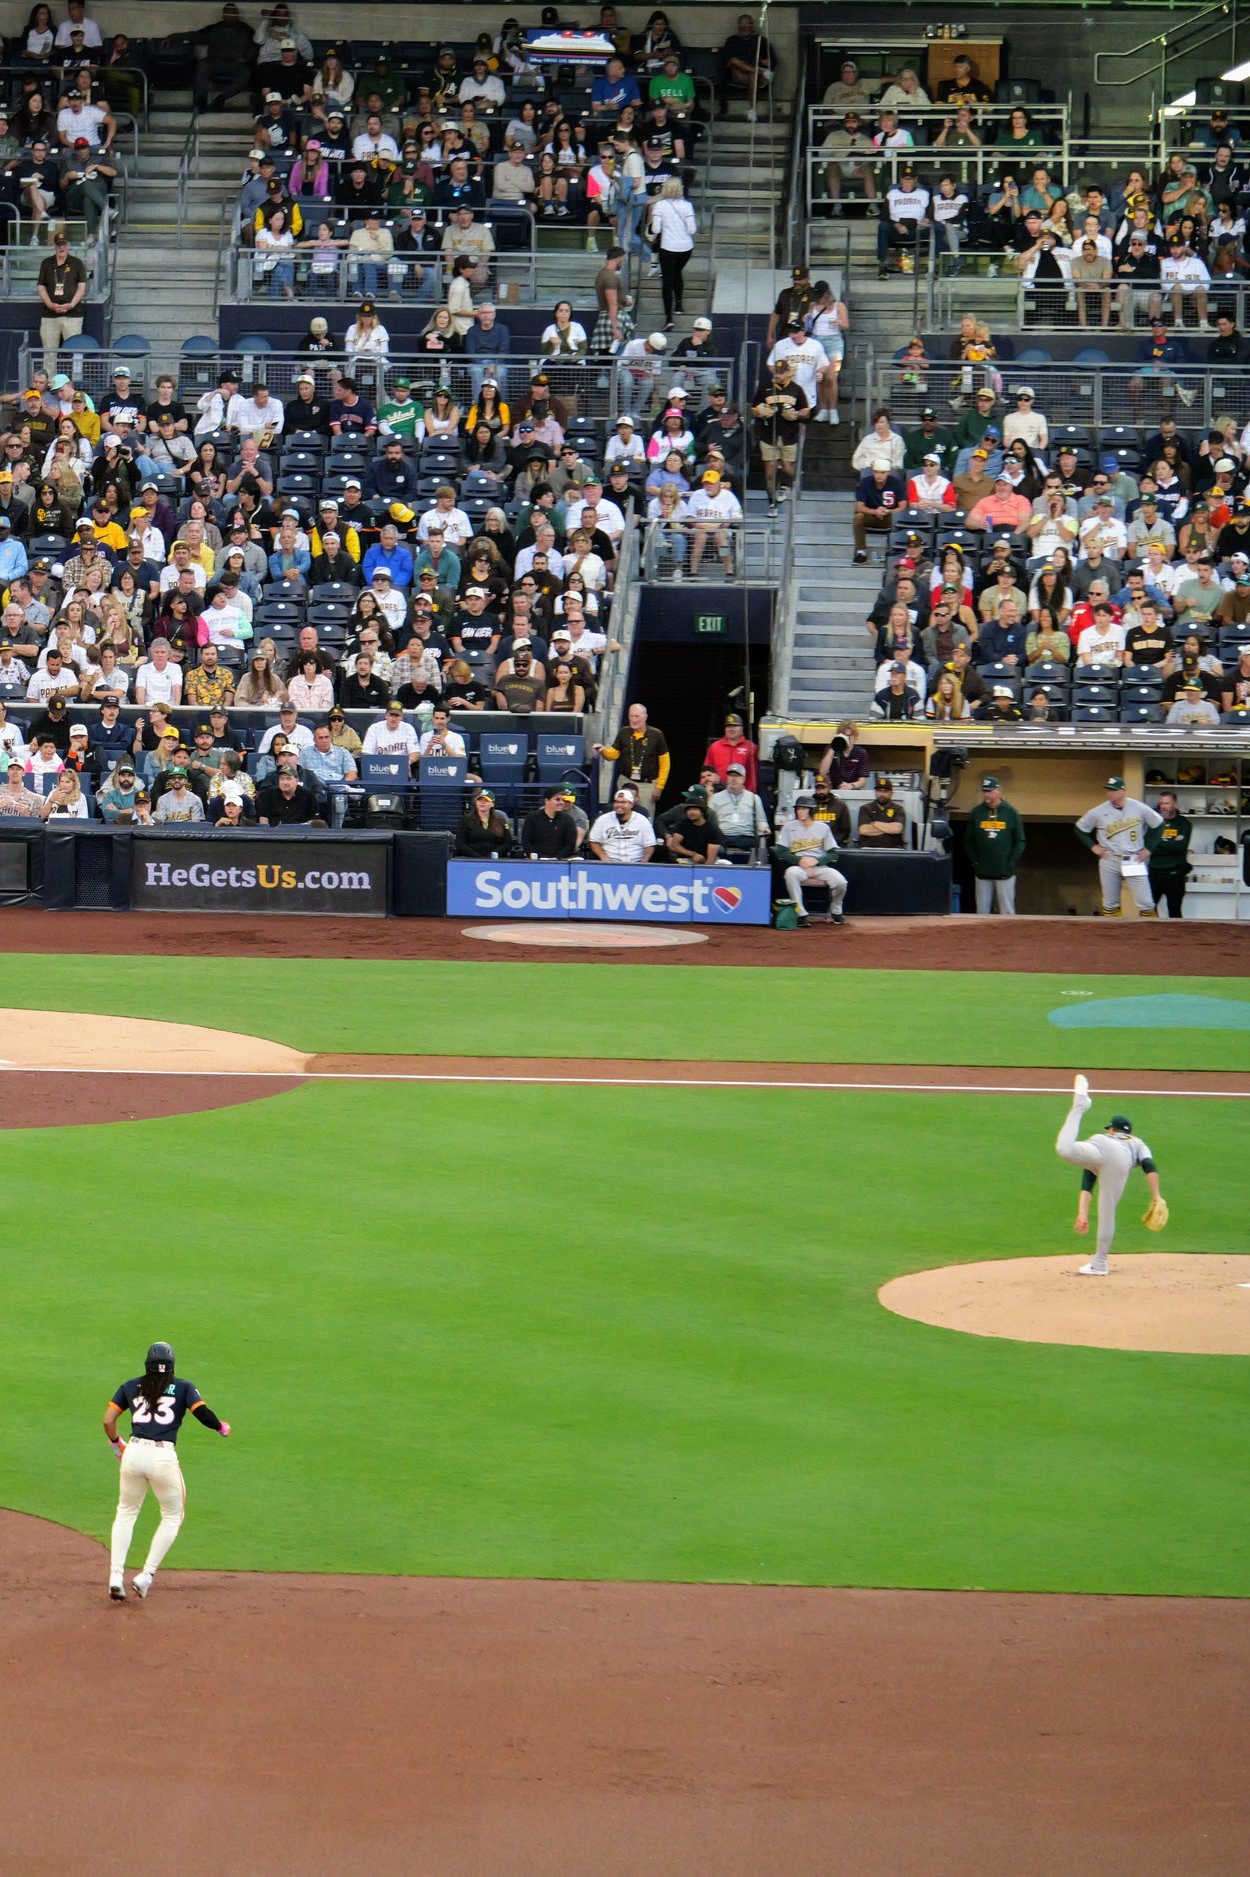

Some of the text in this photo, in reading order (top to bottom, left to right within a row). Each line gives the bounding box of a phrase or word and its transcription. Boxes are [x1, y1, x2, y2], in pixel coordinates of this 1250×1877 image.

[661, 88, 684, 98] SELL
[699, 616, 723, 632] EXIT
[488, 743, 508, 754] blue
[546, 744, 566, 755] blue
[369, 763, 390, 774] blue
[428, 765, 448, 776] blue
[145, 861, 372, 890] HeGetsUs.com
[474, 870, 710, 914] Southwest
[132, 1396, 176, 1425] 23
